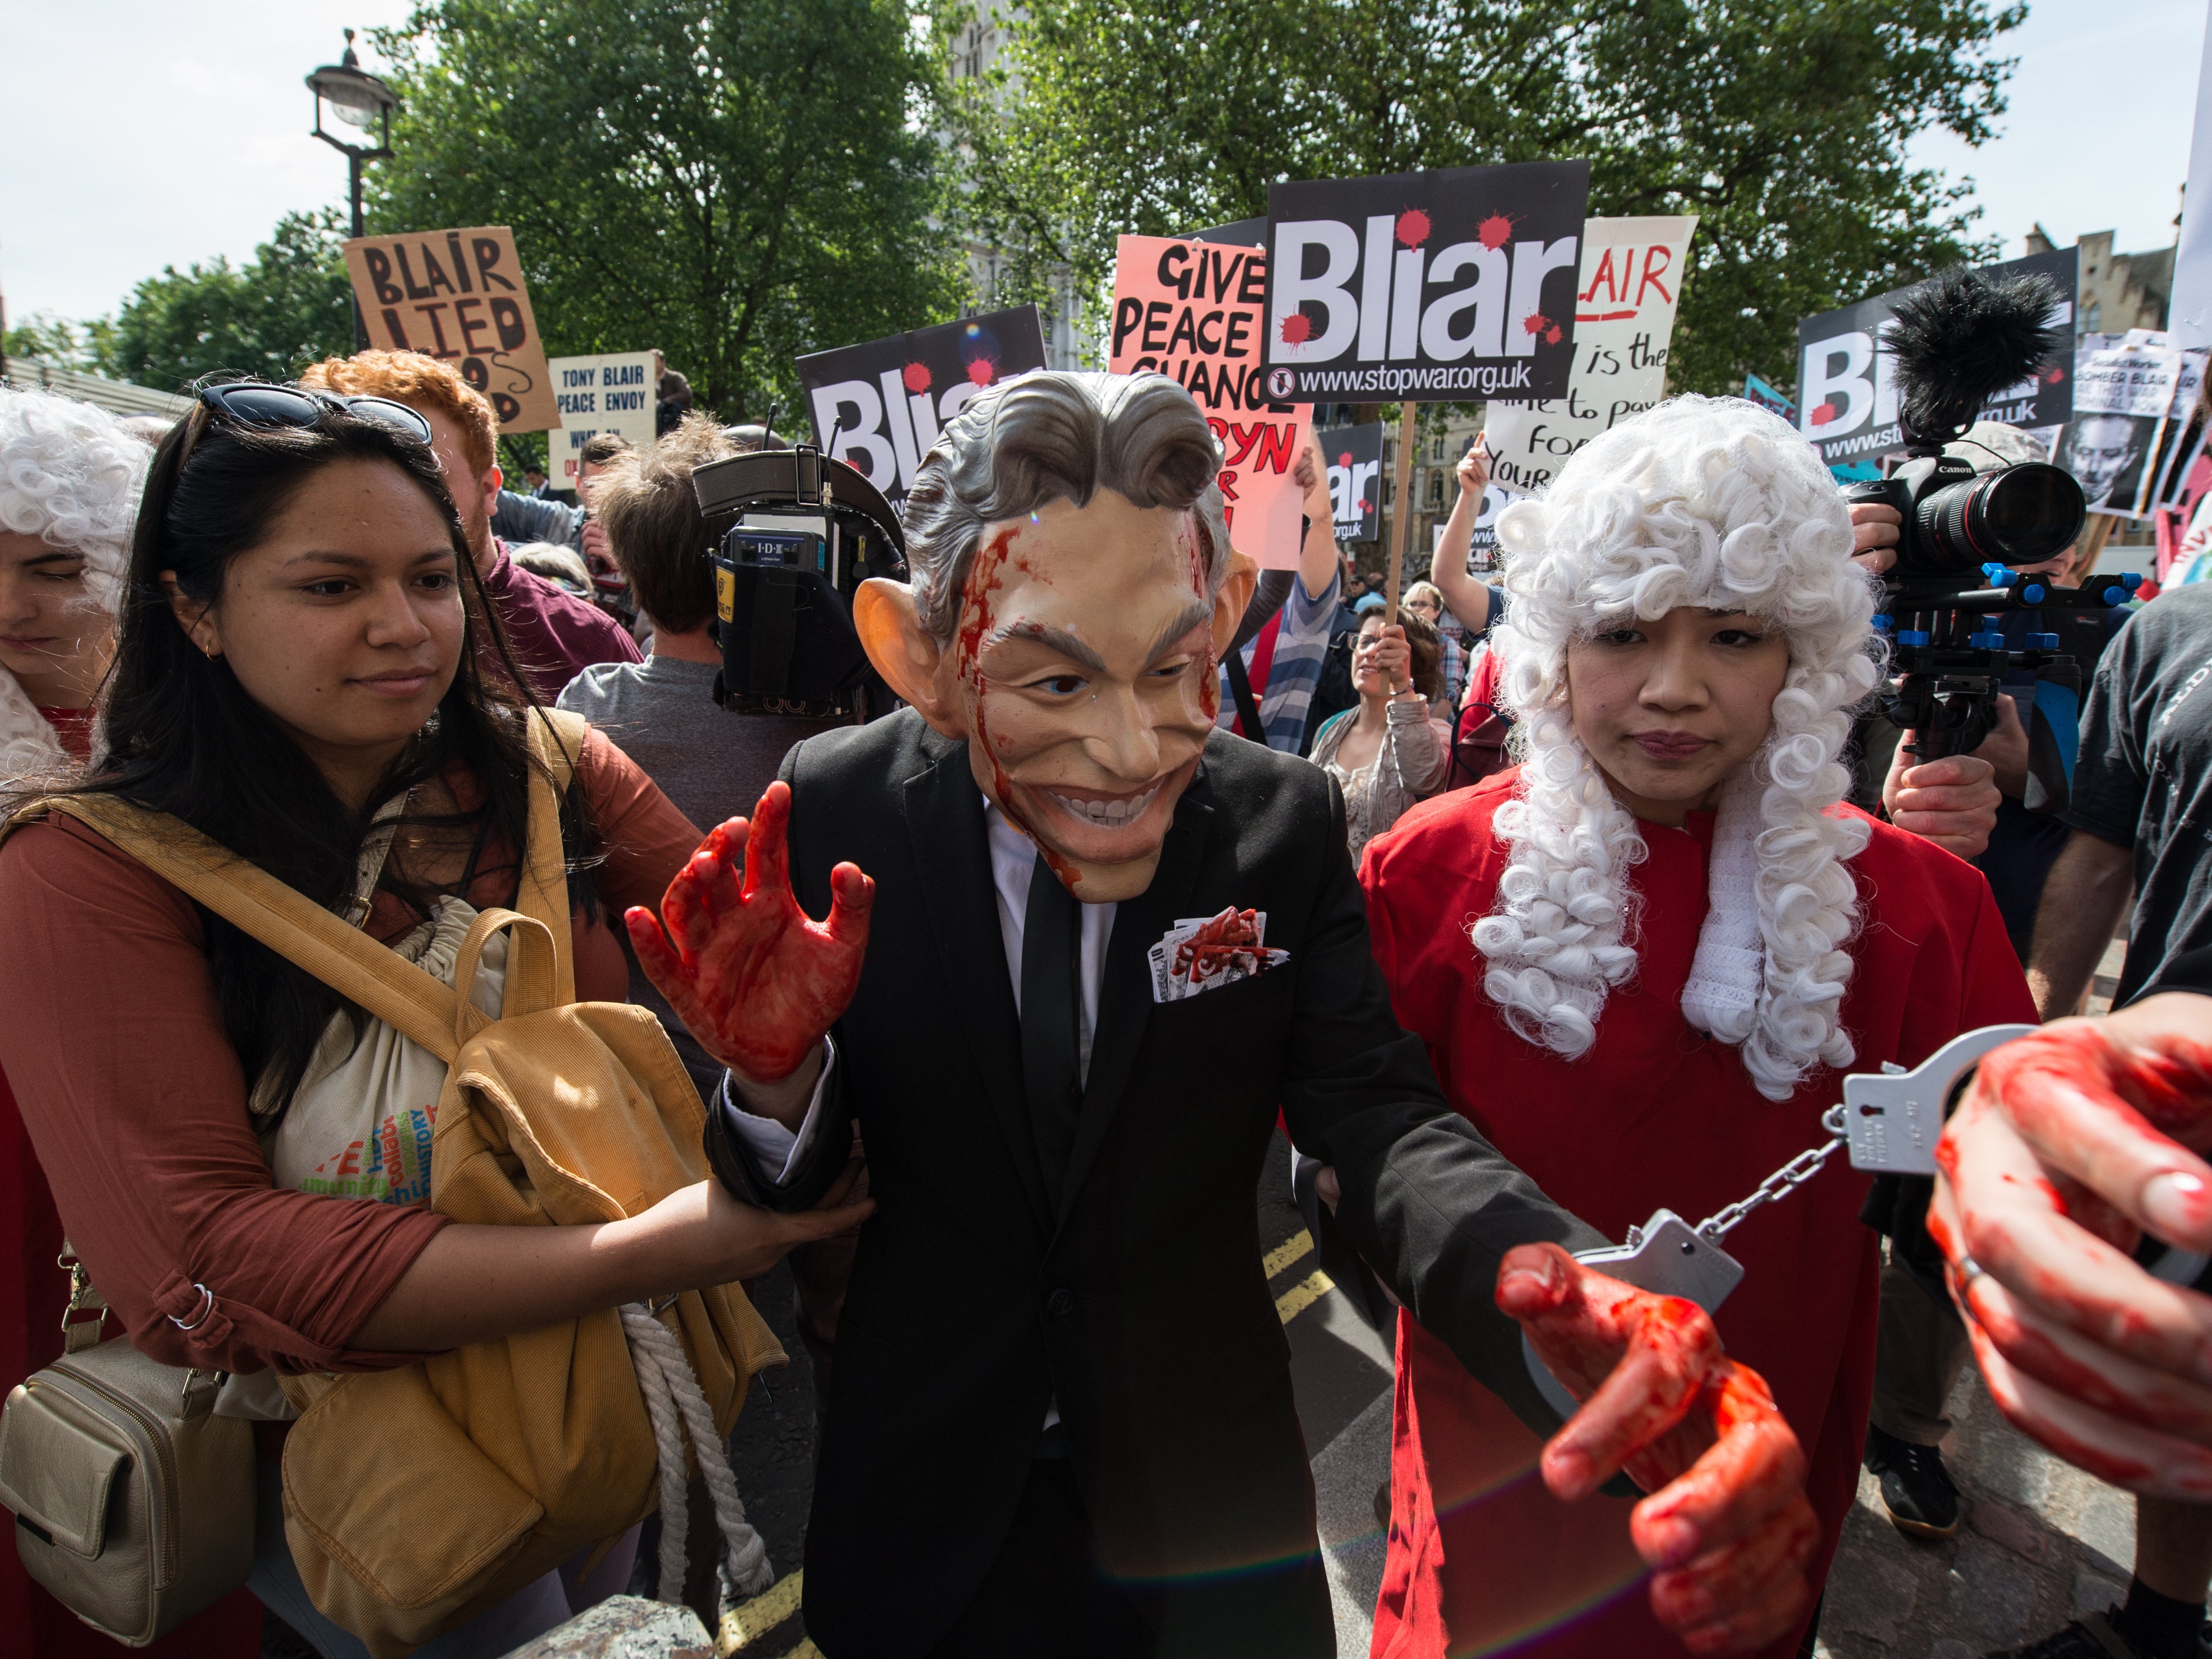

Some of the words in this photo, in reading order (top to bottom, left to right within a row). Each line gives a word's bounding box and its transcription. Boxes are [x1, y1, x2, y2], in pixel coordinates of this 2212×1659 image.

[363, 231, 517, 305] BLAIR
[1158, 244, 1266, 304] GIVE
[1269, 208, 1577, 364] Bliar
[381, 296, 526, 359] LIED
[1112, 296, 1253, 358] PEACE
[1586, 345, 1621, 375] is
[1628, 332, 1668, 370] the
[563, 368, 595, 388] TONY
[603, 365, 644, 386] BLAIR
[1299, 360, 1531, 395] www.stopwar.org.uk
[2076, 372, 2127, 383] BOMBER
[2131, 372, 2168, 385] BLAIR
[558, 393, 595, 414] PEACE
[605, 391, 646, 411] ENVOY
[1564, 387, 1598, 419] to
[2159, 657, 2212, 725] ALD
[298, 1174, 389, 1200] munity
